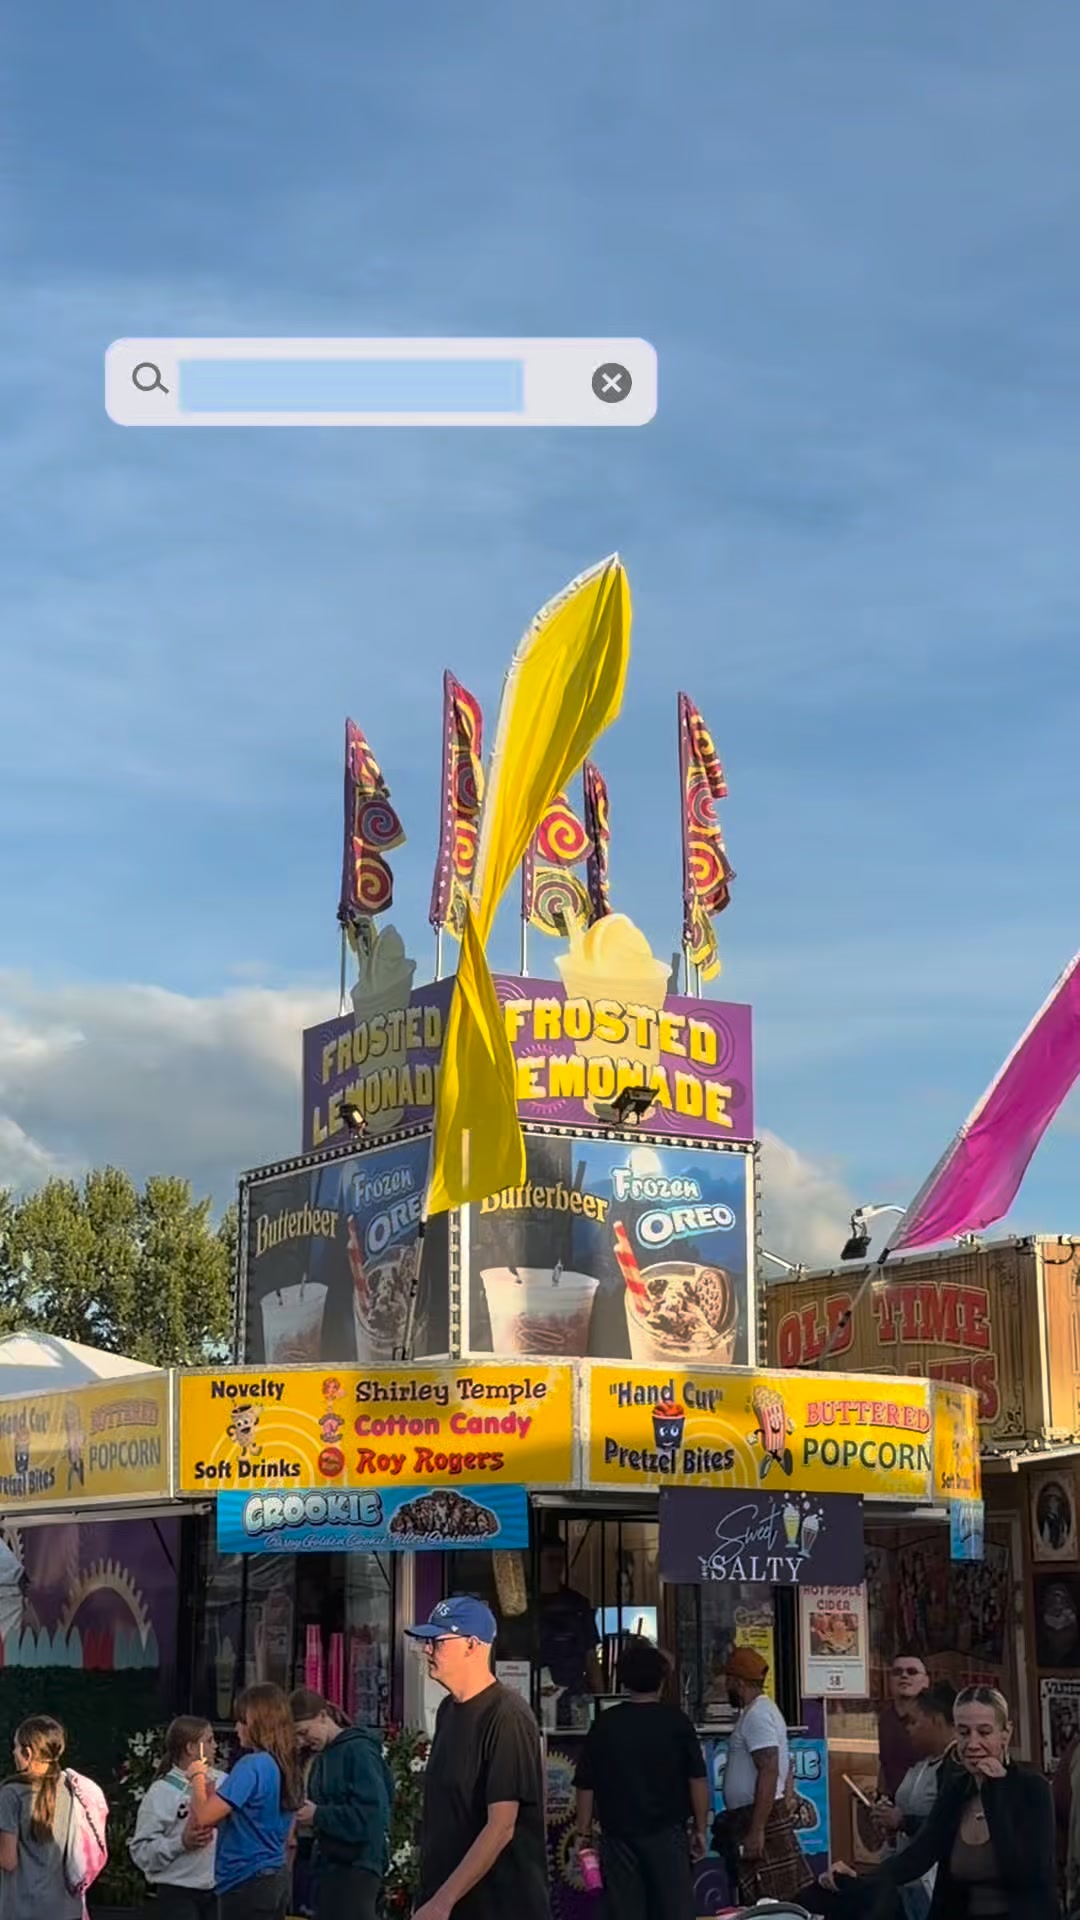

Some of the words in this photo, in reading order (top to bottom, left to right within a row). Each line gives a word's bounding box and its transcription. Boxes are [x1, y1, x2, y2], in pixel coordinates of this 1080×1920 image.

[322, 1006, 441, 1084] FROSTED
[506, 998, 718, 1066] FROSTED
[313, 1064, 442, 1146] LEMONAD
[517, 1055, 734, 1128] EMONADE
[352, 1167, 412, 1206] Frozen
[612, 1168, 698, 1199] Frozen
[256, 1203, 338, 1258] Butterbeer
[367, 1198, 425, 1254] ORE
[640, 1206, 733, 1242] OREO
[779, 1293, 854, 1368] OLD
[873, 1282, 991, 1352] TIME
[211, 1380, 284, 1400] Novelty
[356, 1380, 449, 1405] Shirley
[457, 1379, 547, 1404] Temple
[355, 1414, 439, 1437] Cotton
[450, 1412, 532, 1438] Candy
[804, 1400, 932, 1433] BUTTERED
[90, 1438, 161, 1471] POPCORN
[194, 1460, 231, 1479] Soft
[238, 1459, 301, 1479] Drinks
[357, 1449, 406, 1475] Roy
[414, 1447, 504, 1475] Rogers
[604, 1437, 676, 1473] Pretzel
[683, 1447, 734, 1473] Bites
[803, 1438, 931, 1470] POPCORN
[708, 1503, 782, 1569] Sweet
[711, 1555, 803, 1582] SALTY
[817, 1600, 850, 1611] CIDER
